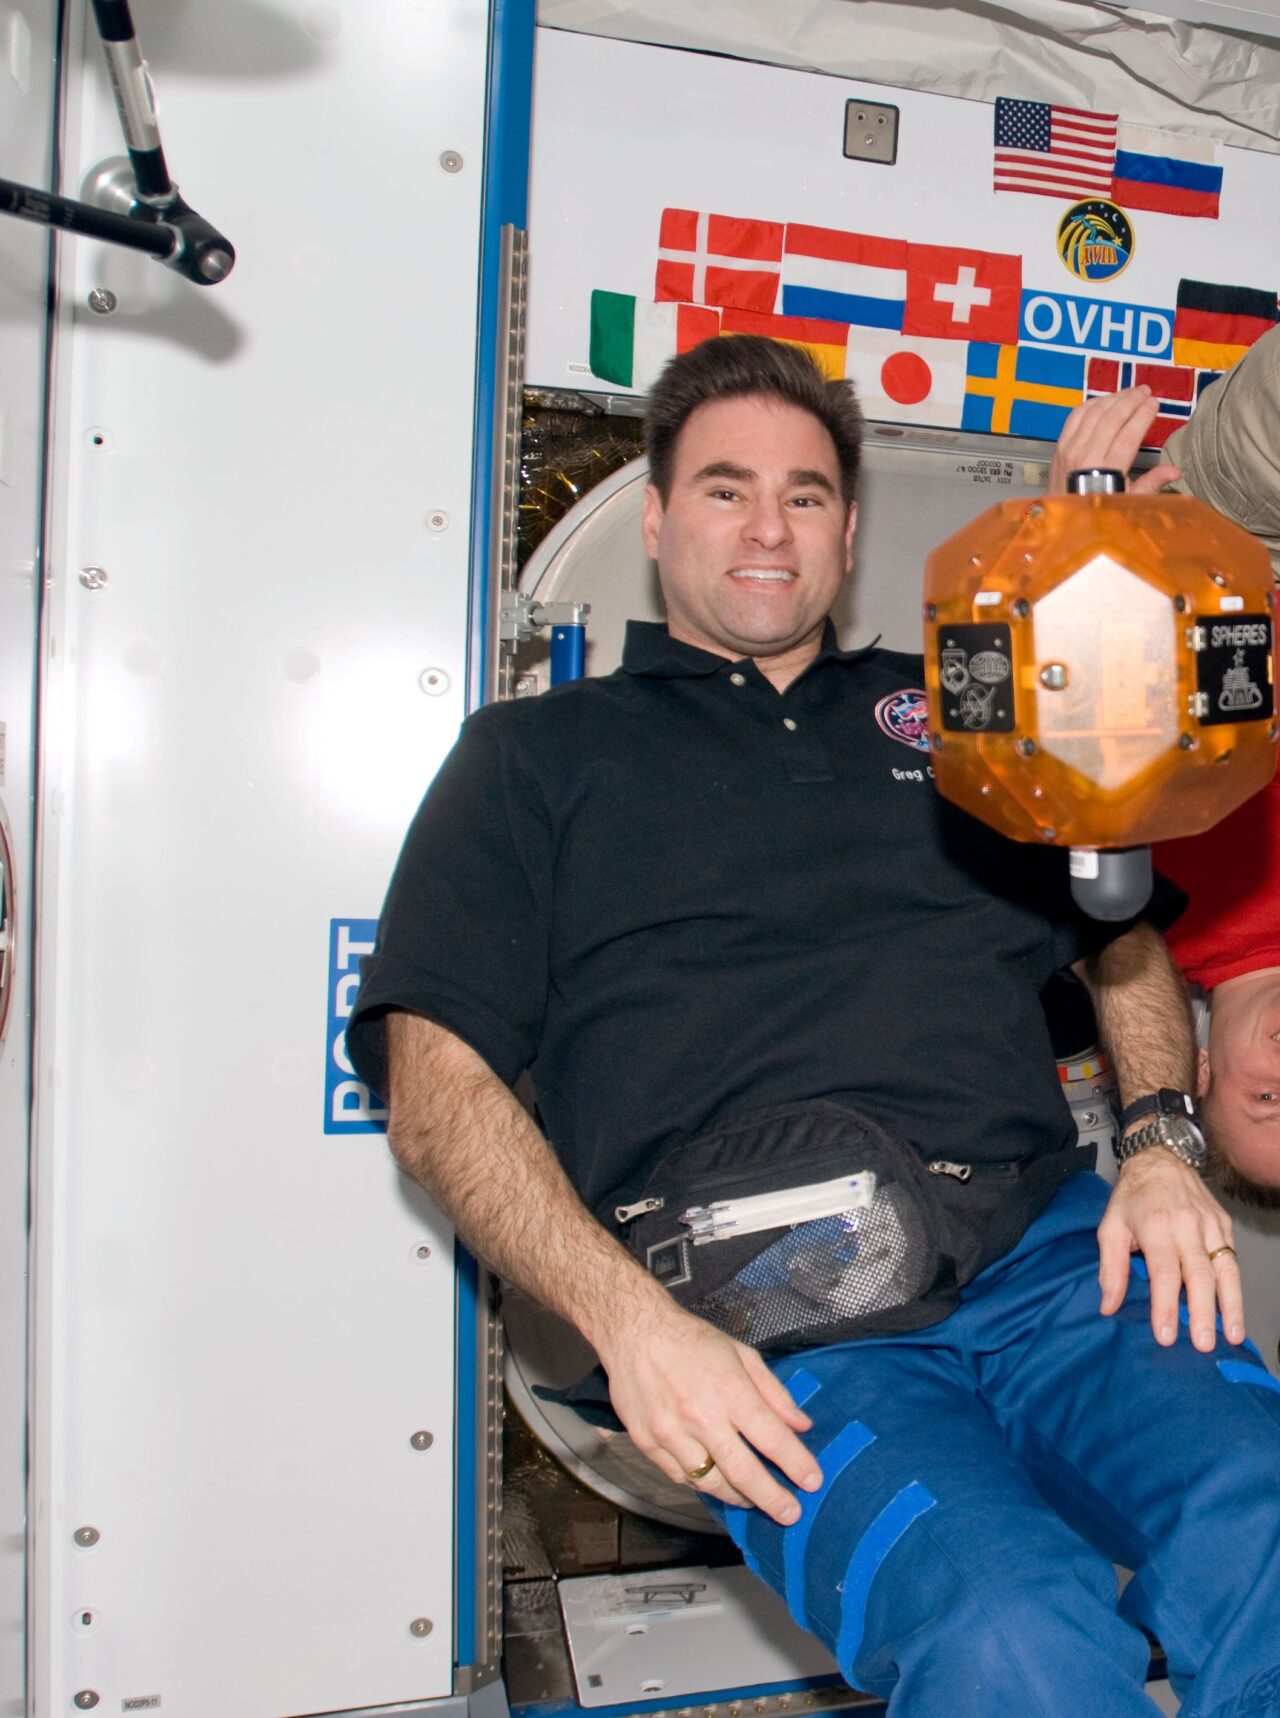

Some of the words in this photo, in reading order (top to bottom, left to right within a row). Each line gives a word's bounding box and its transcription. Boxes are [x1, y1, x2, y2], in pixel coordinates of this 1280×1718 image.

[1024, 295, 1172, 354] OVHD
[1211, 624, 1268, 648] SPHERES
[891, 768, 923, 782] Greg
[332, 926, 390, 1122] PT
